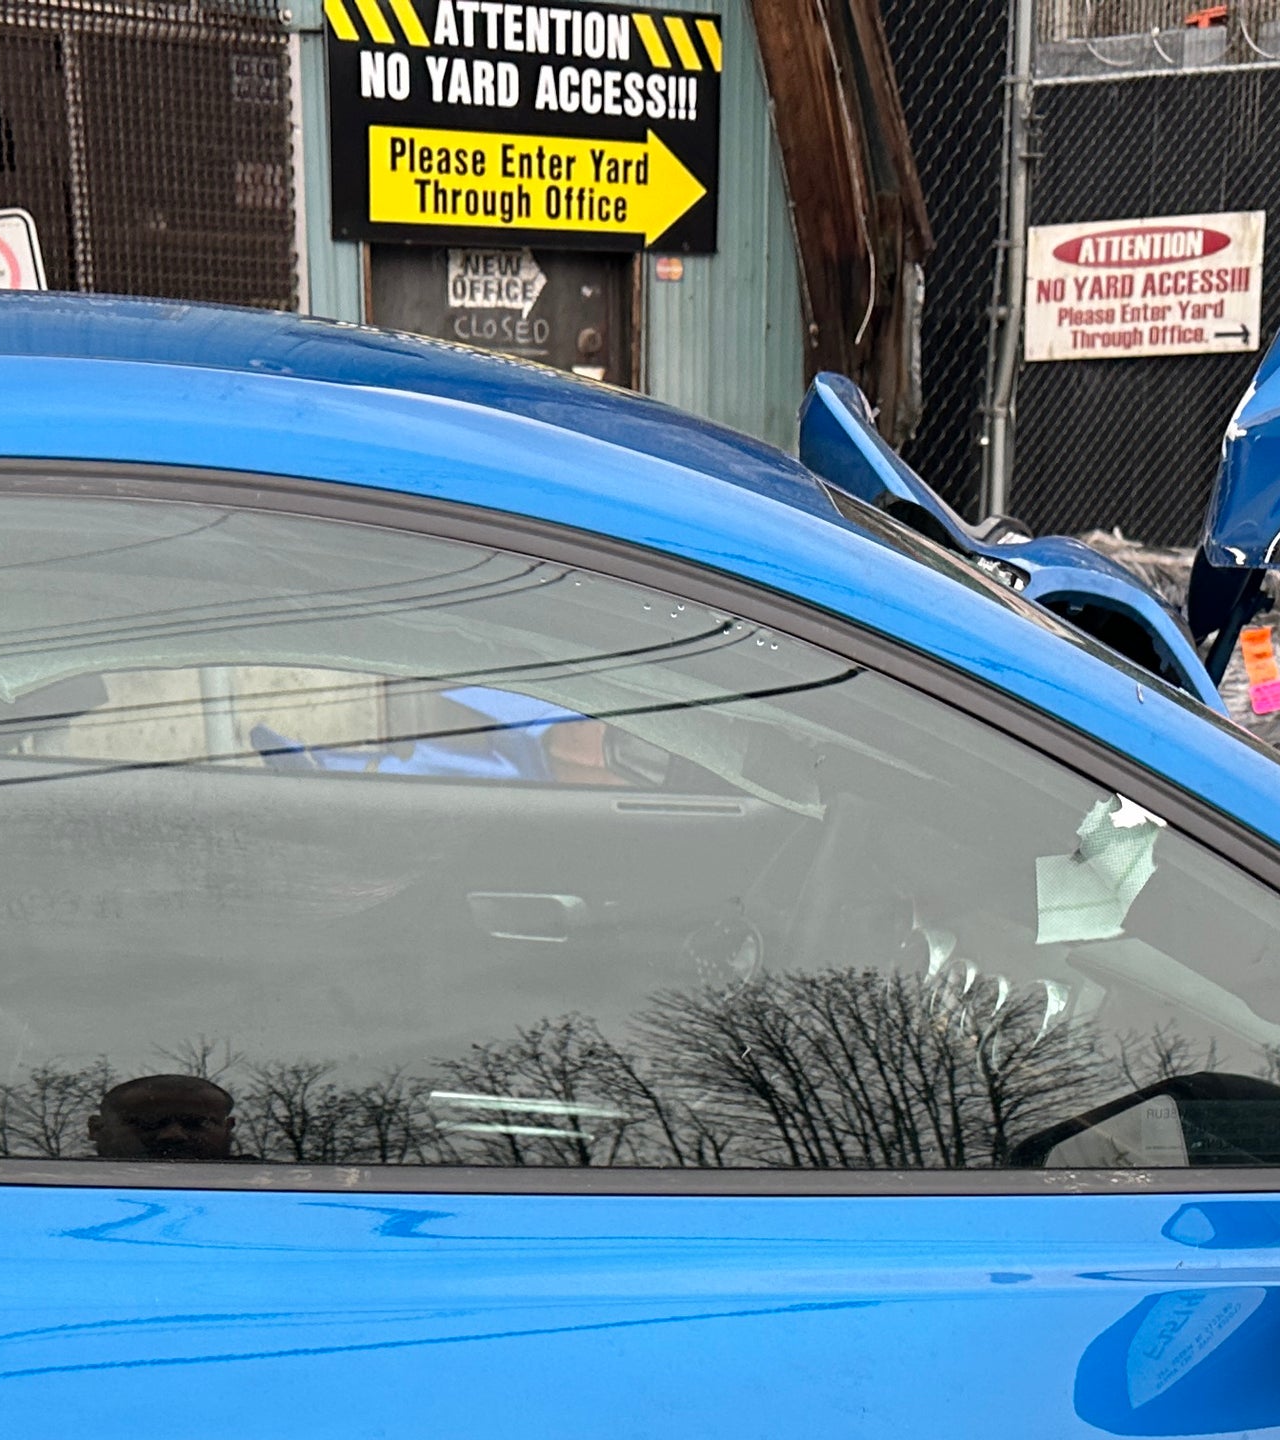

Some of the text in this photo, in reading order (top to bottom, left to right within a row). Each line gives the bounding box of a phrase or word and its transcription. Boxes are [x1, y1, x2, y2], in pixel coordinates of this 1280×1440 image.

[433, 0, 631, 60] ATTENTION
[359, 50, 699, 121] NO YARD ACCESS!!!
[389, 136, 650, 186] Please Enter Yard
[414, 179, 629, 224] Through Office
[463, 253, 520, 276] NEW
[1077, 230, 1205, 264] ATTENTION
[452, 274, 535, 302] OFFICE
[1036, 266, 1252, 304] NO YARD ACCESS!!!
[1057, 299, 1225, 327] Please Enter Yard
[1071, 327, 1143, 350] Through
